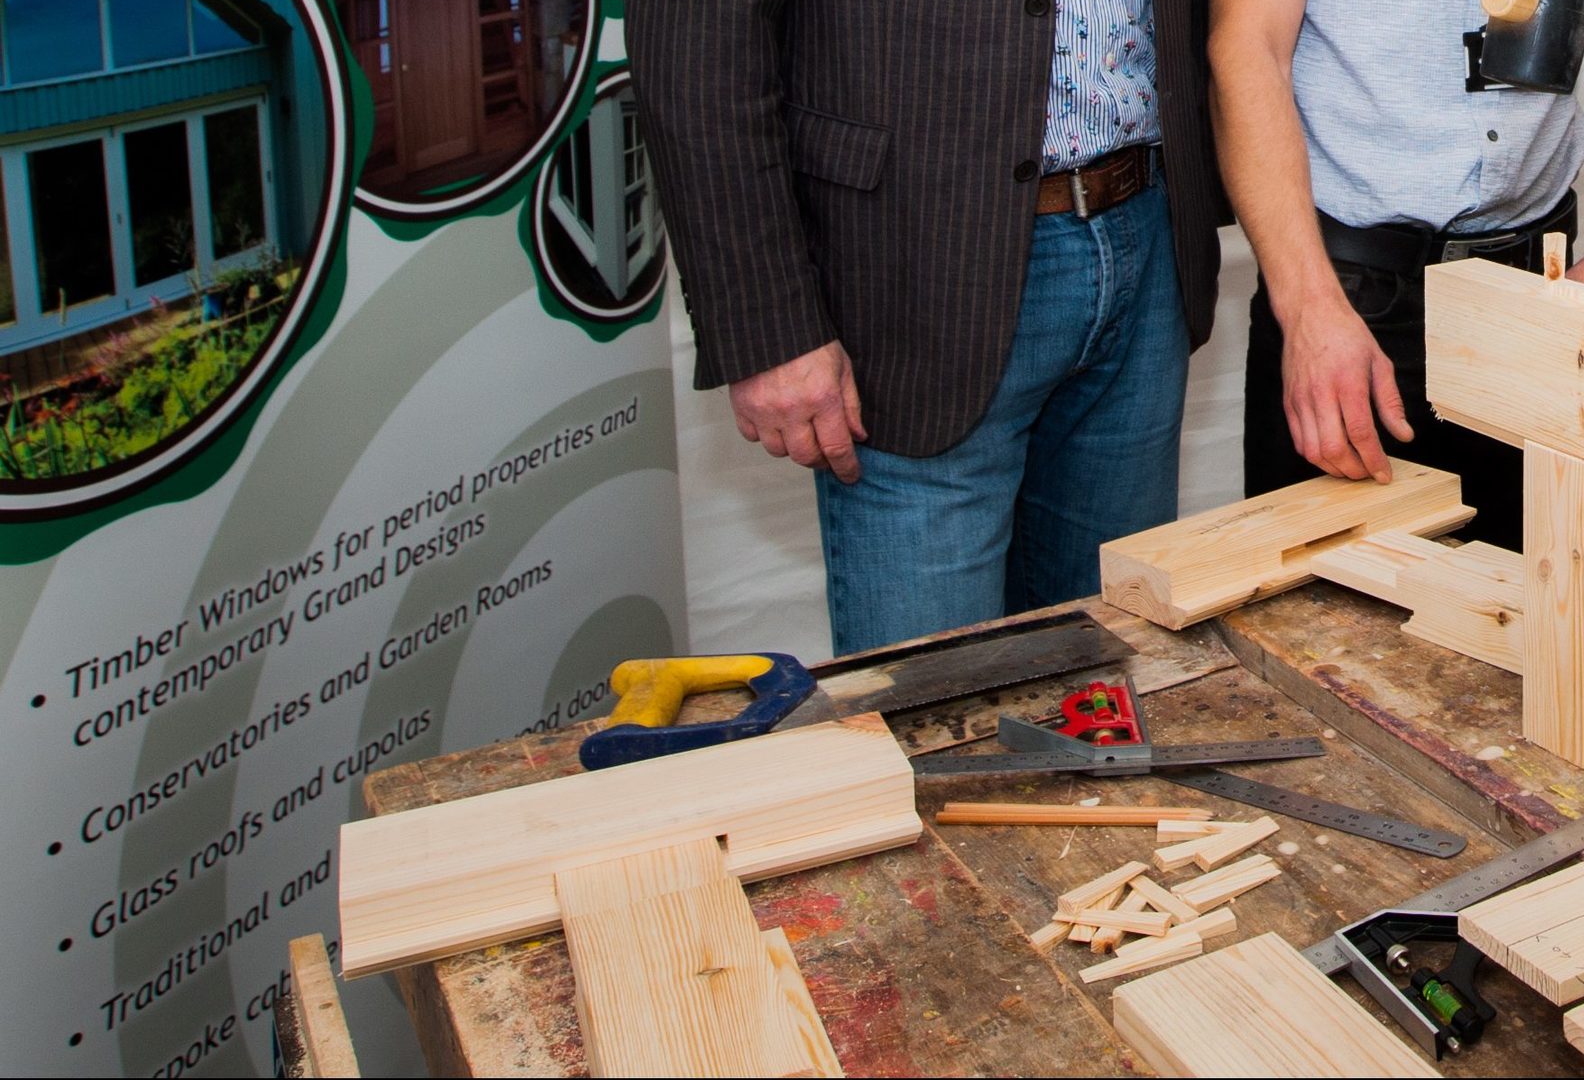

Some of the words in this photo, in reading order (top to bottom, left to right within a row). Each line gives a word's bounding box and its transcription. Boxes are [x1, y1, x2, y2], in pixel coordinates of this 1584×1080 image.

[65, 620, 188, 698] Timber
[199, 551, 324, 632] Windows
[333, 524, 374, 571] for
[382, 475, 464, 547] period
[471, 421, 594, 502] properties
[600, 397, 638, 437] and
[73, 611, 294, 748] contemporary
[303, 556, 386, 623] Grand
[394, 513, 485, 577] Designs
[81, 692, 311, 844] Conservatories
[320, 652, 370, 704] and
[379, 603, 468, 670] Garden
[476, 559, 552, 616] Rooms
[91, 868, 178, 939] Glass
[189, 811, 263, 879] roofs
[272, 767, 323, 823] and
[332, 709, 431, 784] cupolas
[100, 891, 269, 1032] Traditional
[280, 850, 331, 908] and
